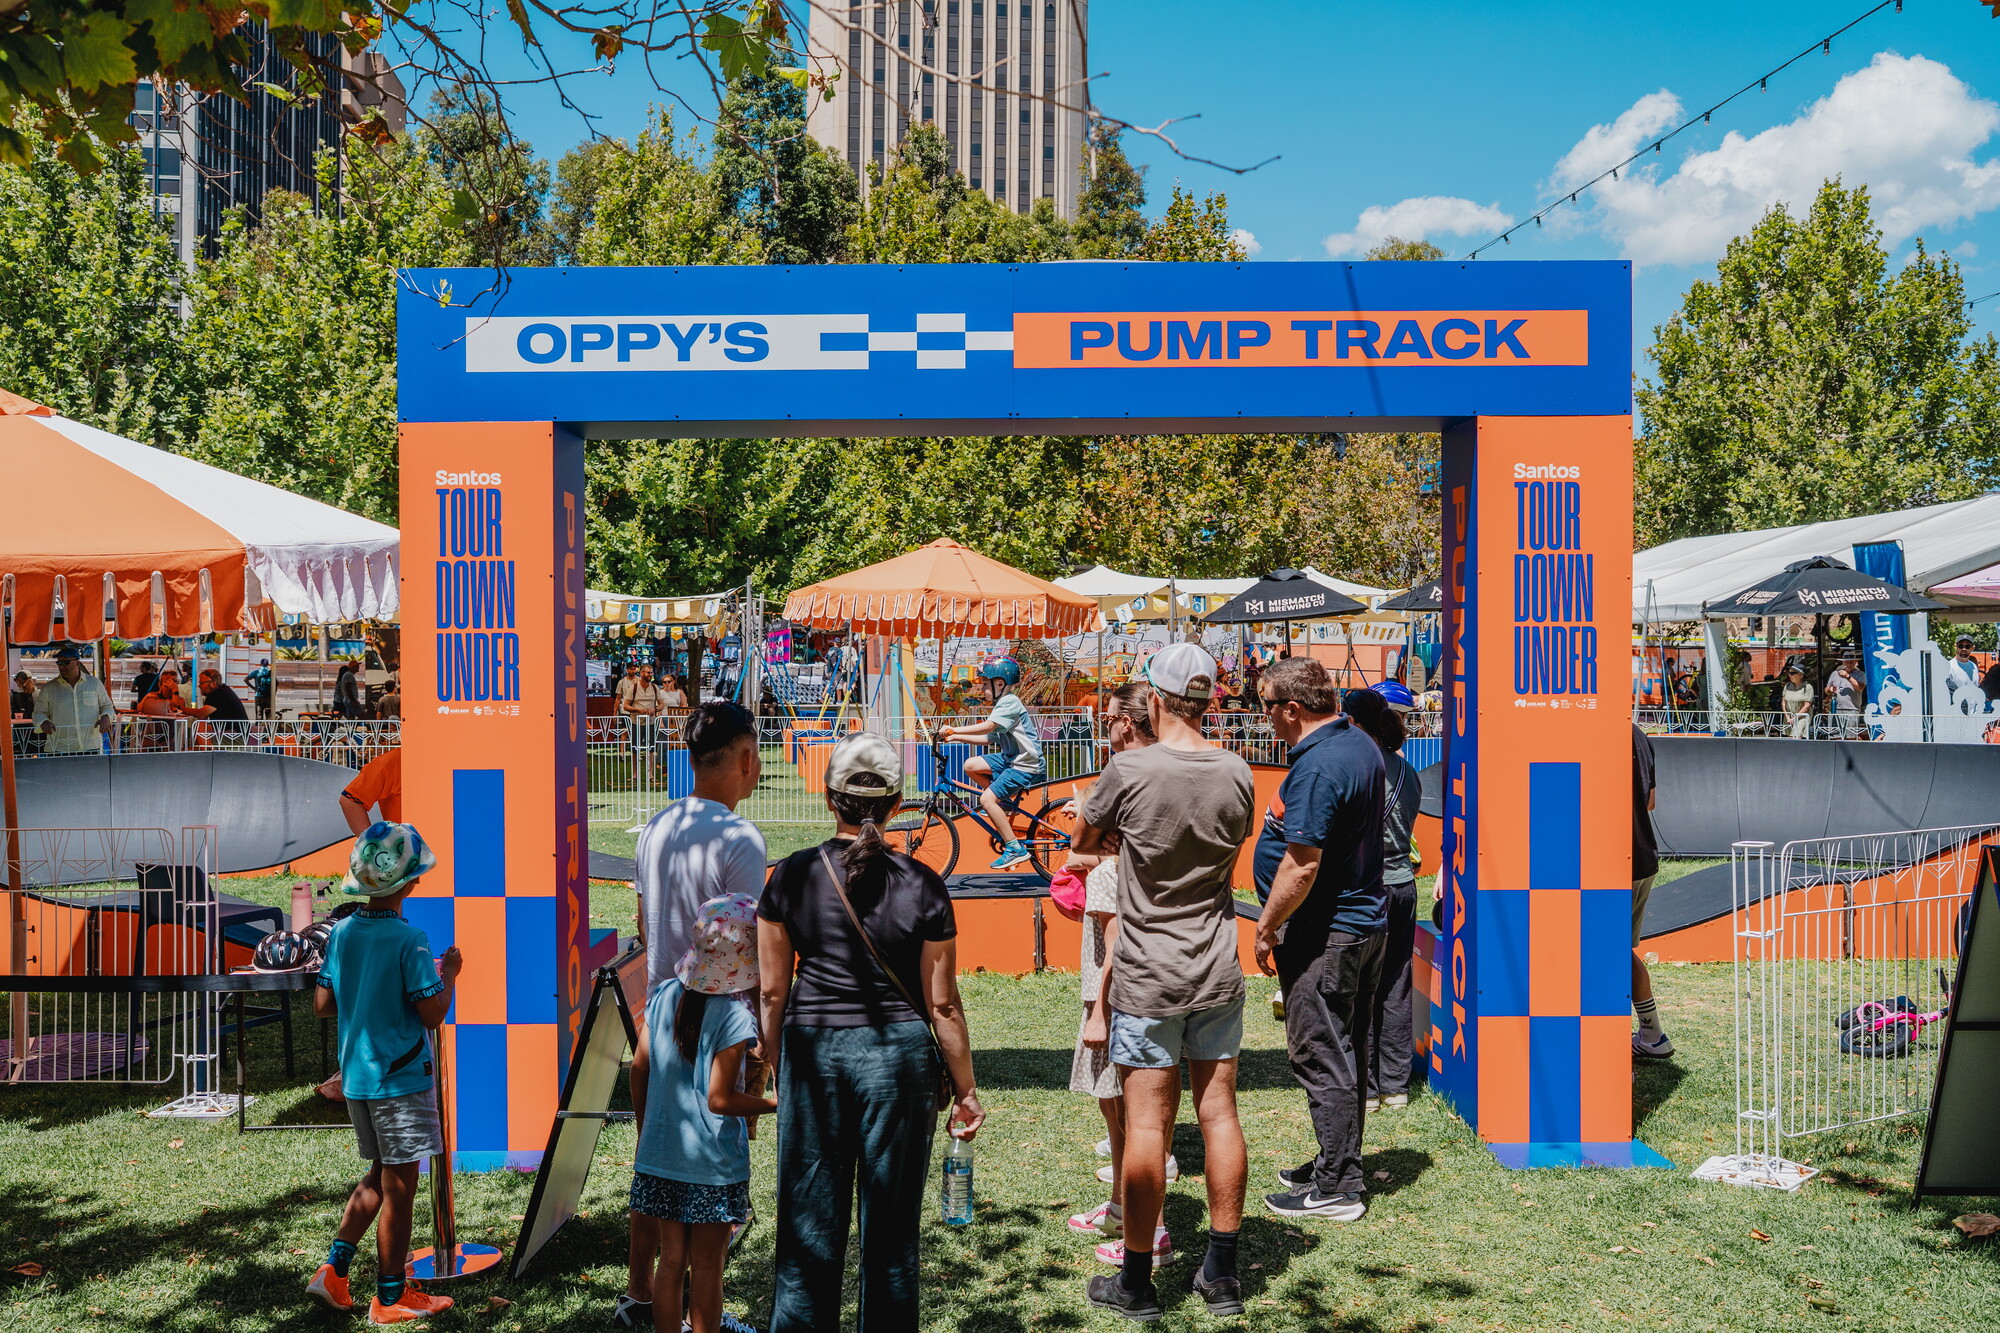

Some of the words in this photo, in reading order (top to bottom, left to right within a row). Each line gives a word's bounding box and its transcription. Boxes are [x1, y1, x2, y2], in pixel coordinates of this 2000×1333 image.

[515, 321, 770, 364] OPPY'S
[1070, 321, 1271, 361] PUMP
[1290, 318, 1531, 360] TRACK
[435, 469, 502, 486] Santos
[1513, 462, 1580, 479] Santos
[436, 488, 503, 557] TOUR
[1514, 481, 1581, 550] TOUR
[436, 560, 515, 629] DOWN
[563, 491, 578, 742] PUMP
[1268, 592, 1325, 607] MISMATCH
[1268, 602, 1312, 613] BREWING
[1452, 485, 1466, 737] PUMP
[1514, 553, 1593, 623] DOWN
[1821, 587, 1887, 599] MISMATCH
[1825, 593, 1875, 605] BREWING
[437, 632, 521, 702] UNDER
[1514, 626, 1598, 695] UNDER
[1452, 762, 1467, 1064] TRACK
